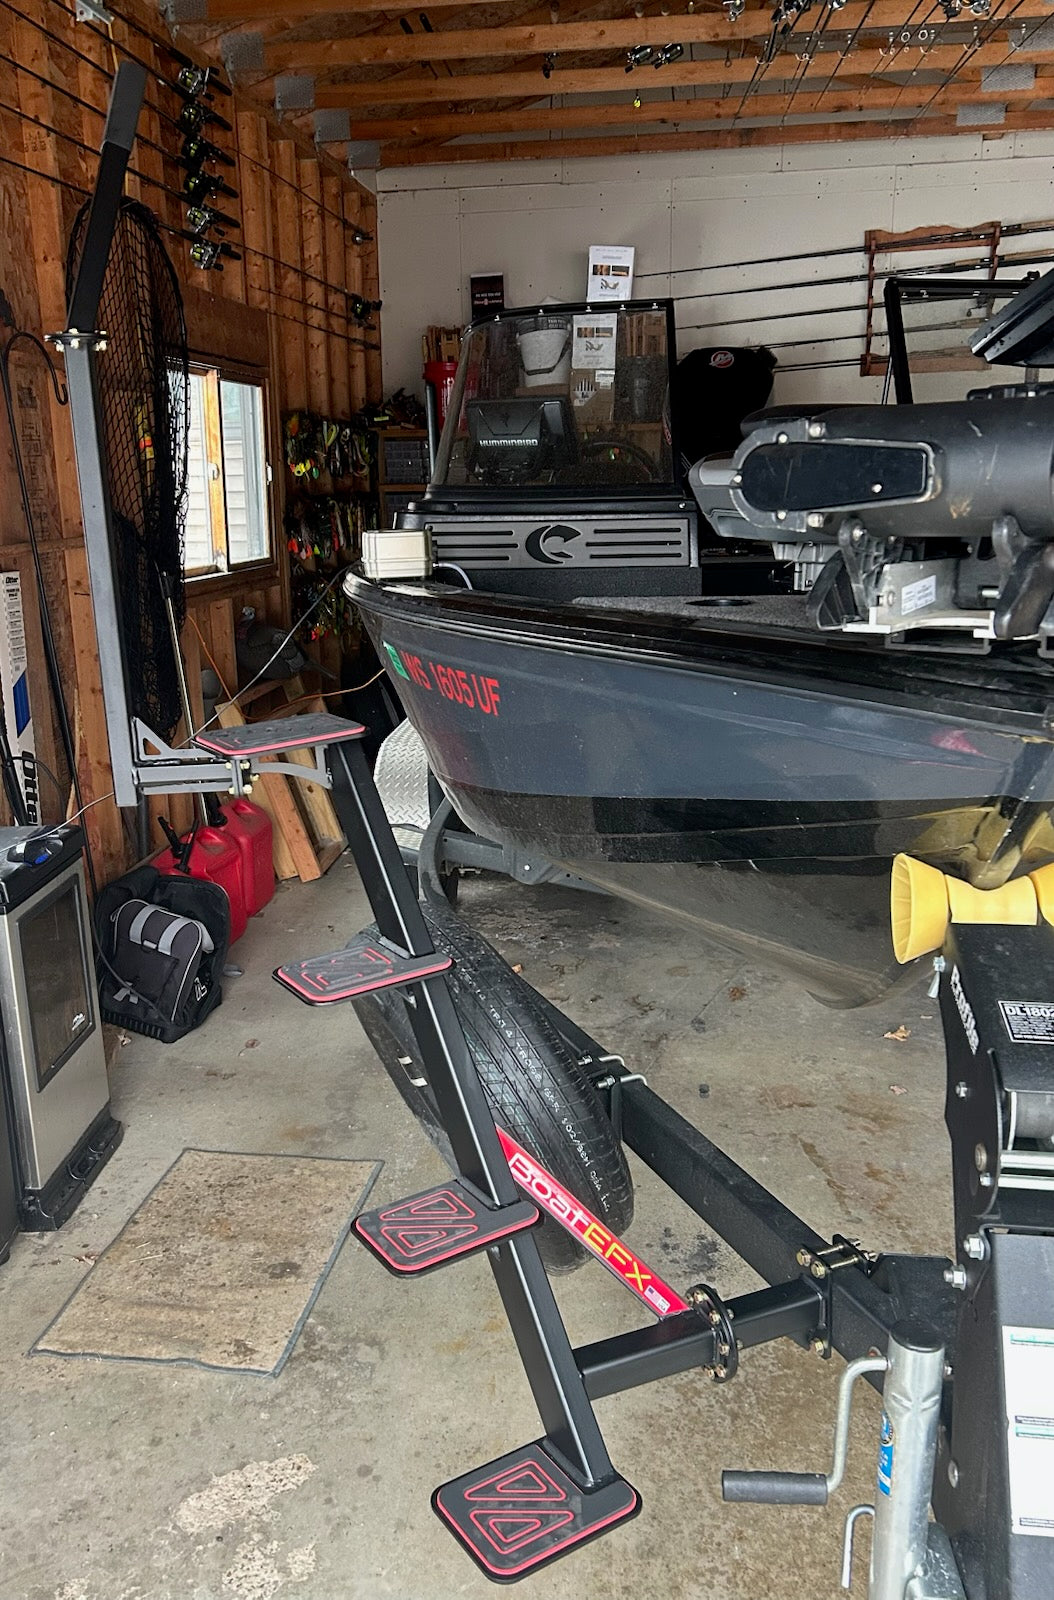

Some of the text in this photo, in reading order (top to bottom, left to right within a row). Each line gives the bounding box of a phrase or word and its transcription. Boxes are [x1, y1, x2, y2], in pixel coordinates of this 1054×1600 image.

[479, 439, 539, 448] HUMMINBIRD
[400, 649, 432, 690] WS
[428, 662, 475, 708] 1605
[470, 674, 500, 717] UF
[21, 750, 38, 826] Otte
